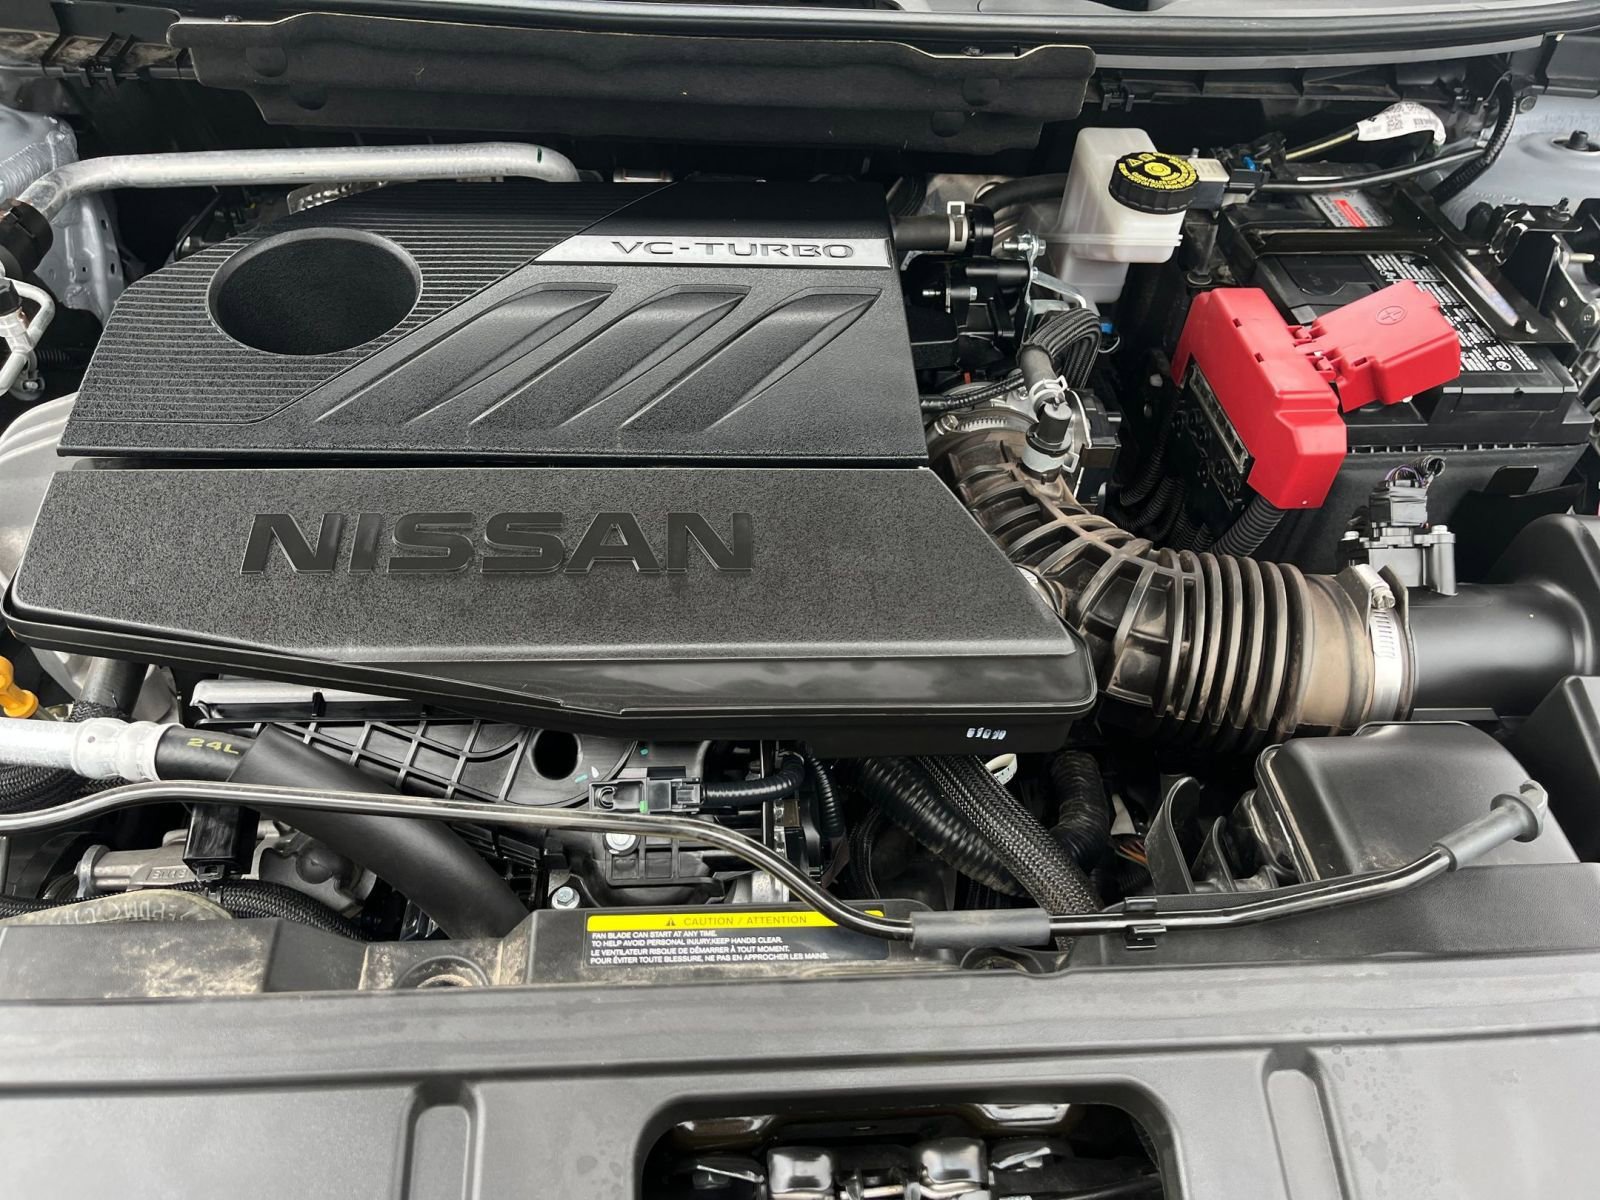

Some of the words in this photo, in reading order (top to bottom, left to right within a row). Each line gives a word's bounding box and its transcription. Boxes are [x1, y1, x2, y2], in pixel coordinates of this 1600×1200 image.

[611, 240, 854, 258] VC-TURBO
[239, 511, 753, 575] NISSAN
[186, 737, 240, 755] 24L
[683, 916, 734, 927] CAUTION
[746, 915, 807, 925] ATTENTION
[592, 932, 607, 940] FAN
[607, 931, 632, 940] BLADE
[632, 931, 649, 939] CAN
[649, 931, 673, 939] START
[683, 930, 699, 938] ANY
[592, 940, 602, 948] TO
[603, 940, 622, 948] HELP
[622, 939, 646, 947] AVOID
[646, 938, 686, 946] PERSONAL
[757, 936, 783, 944] CLEAR.
[591, 949, 601, 957] LE
[601, 948, 649, 956] VENTILATEUR
[648, 947, 677, 955] RISQUE
[677, 946, 689, 954] DE
[689, 945, 729, 954] DÉMARRER
[730, 944, 736, 953] À
[737, 945, 756, 953] TOUT
[756, 945, 791, 953] MOMENT.
[590, 957, 612, 965] POUR
[613, 955, 639, 964] ÉVITER
[638, 956, 663, 964] TOUTE
[704, 954, 715, 962] NE
[716, 953, 732, 962] PAS
[731, 953, 744, 961] EN
[744, 952, 789, 961] APPROCHER
[789, 951, 805, 960] LES
